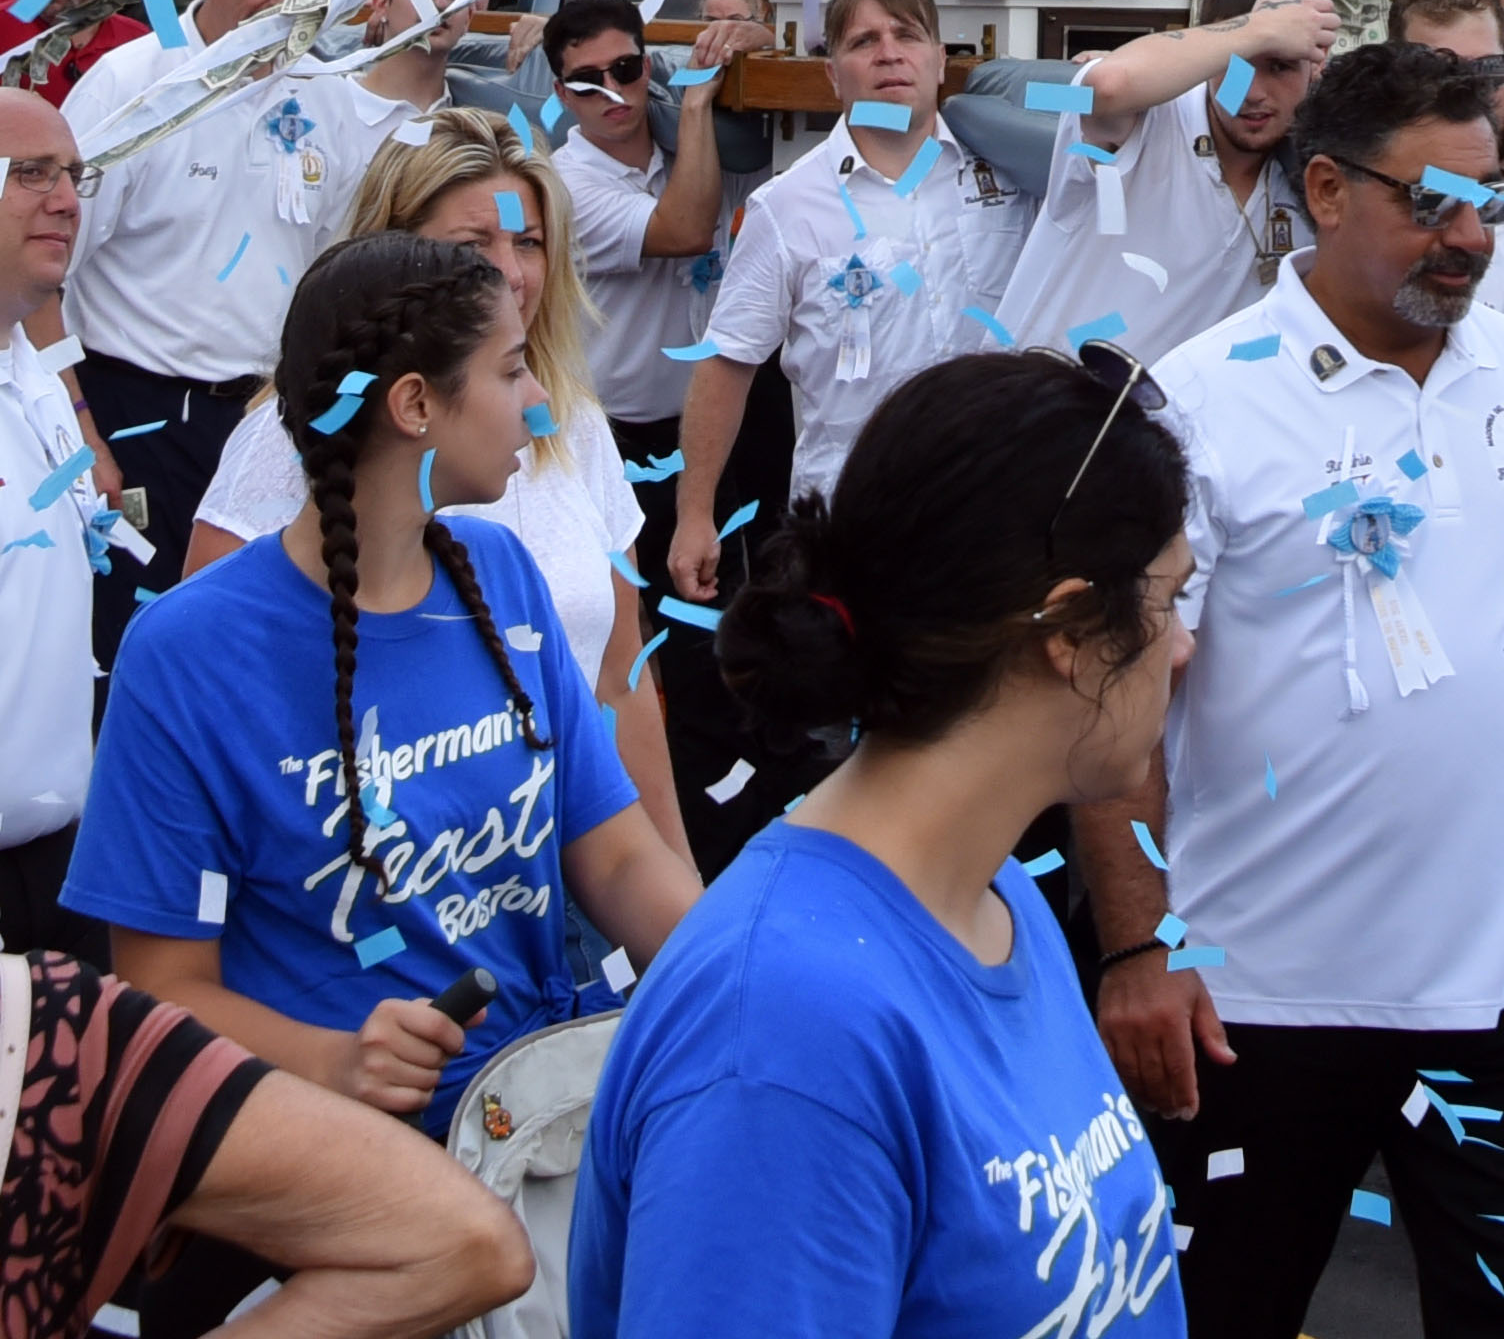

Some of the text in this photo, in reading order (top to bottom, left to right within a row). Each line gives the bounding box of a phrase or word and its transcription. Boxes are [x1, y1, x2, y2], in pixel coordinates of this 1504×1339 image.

[188, 162, 218, 181] Joey
[279, 755, 304, 775] The
[303, 755, 556, 943] Feast
[436, 874, 551, 945] Boston
[983, 1155, 1013, 1186] The
